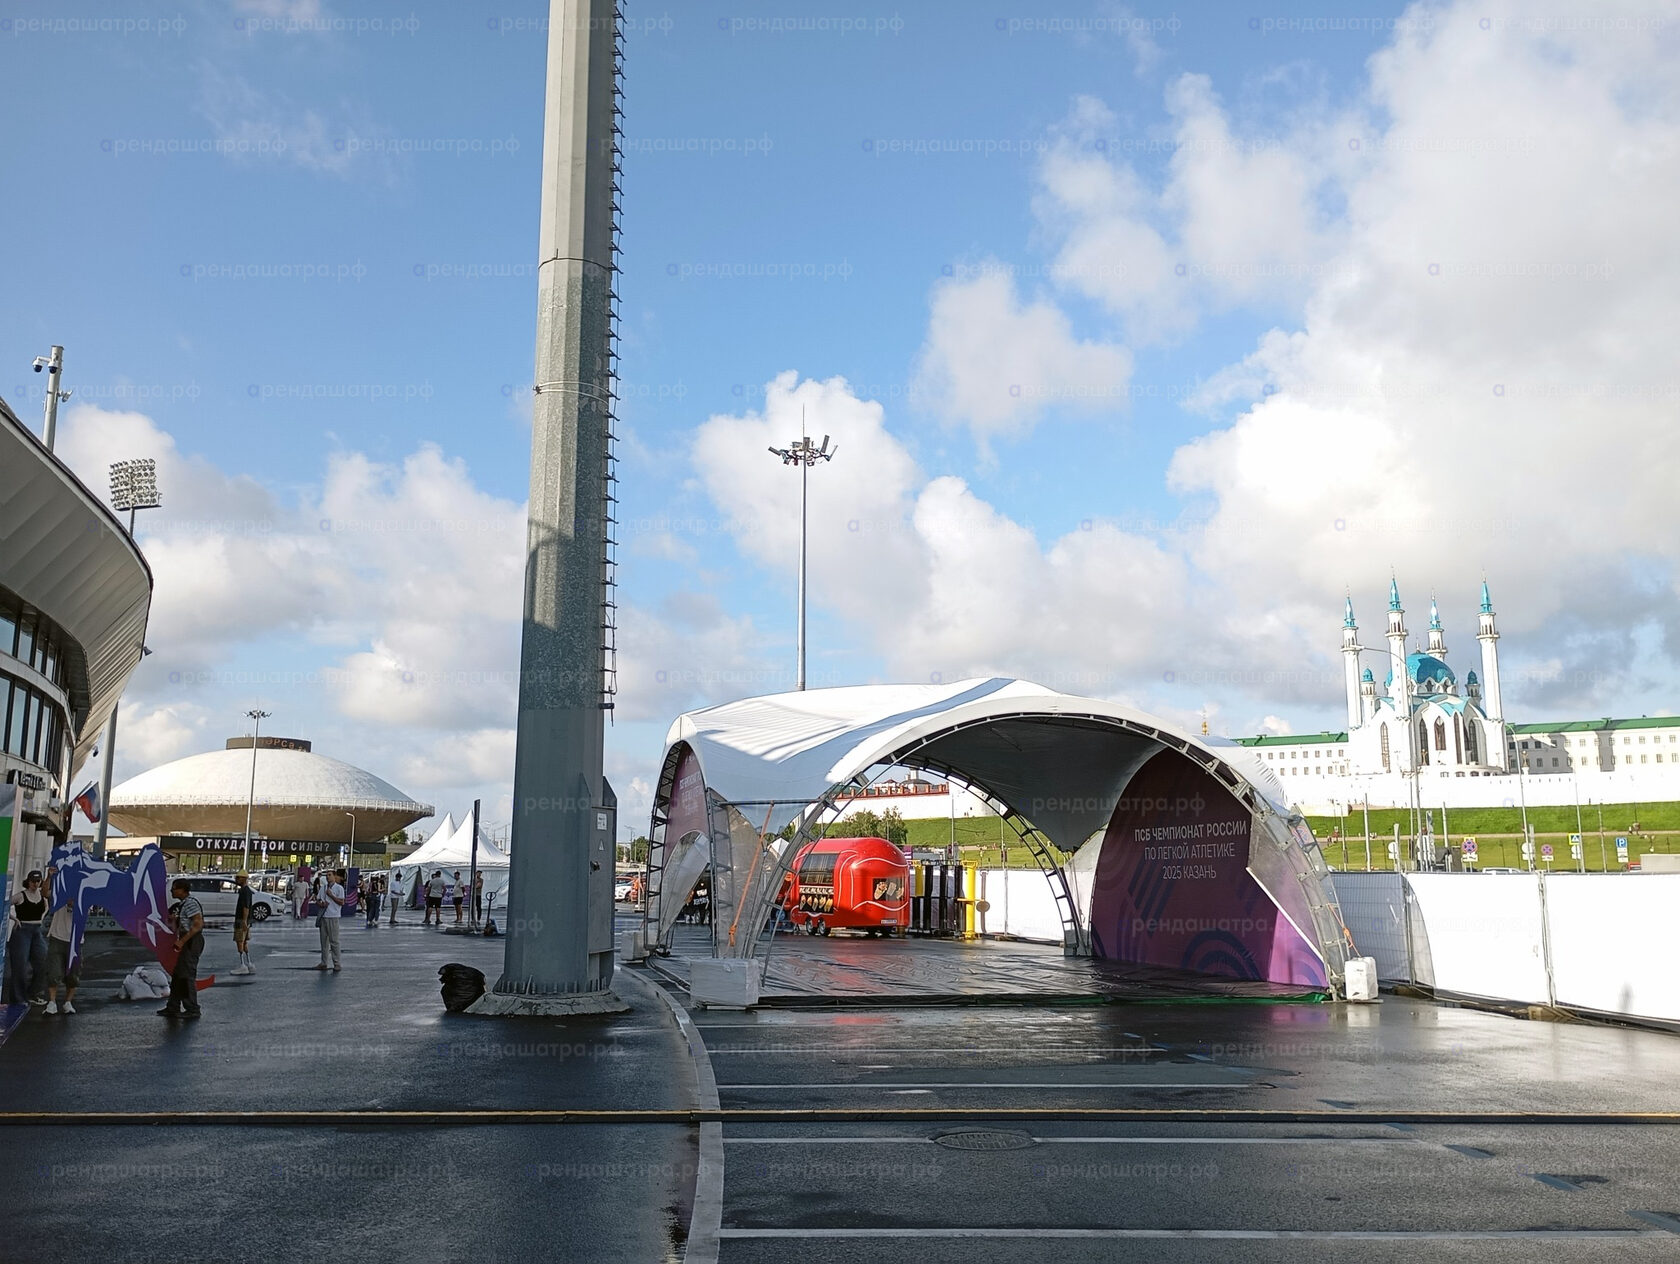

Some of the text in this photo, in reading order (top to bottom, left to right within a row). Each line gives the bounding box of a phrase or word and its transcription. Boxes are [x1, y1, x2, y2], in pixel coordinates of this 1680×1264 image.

[1135, 821, 1247, 842] ПСБ ЧЕМПИОНАТ РОССИИ
[196, 838, 330, 851] ОТКУДА ТВОИ СИЛЫ?
[1144, 842, 1235, 860] ПО ЛЕГКОЙ АТЛЕТИКЕ
[1163, 865, 1216, 879] 2025 КАЗАНЬ
